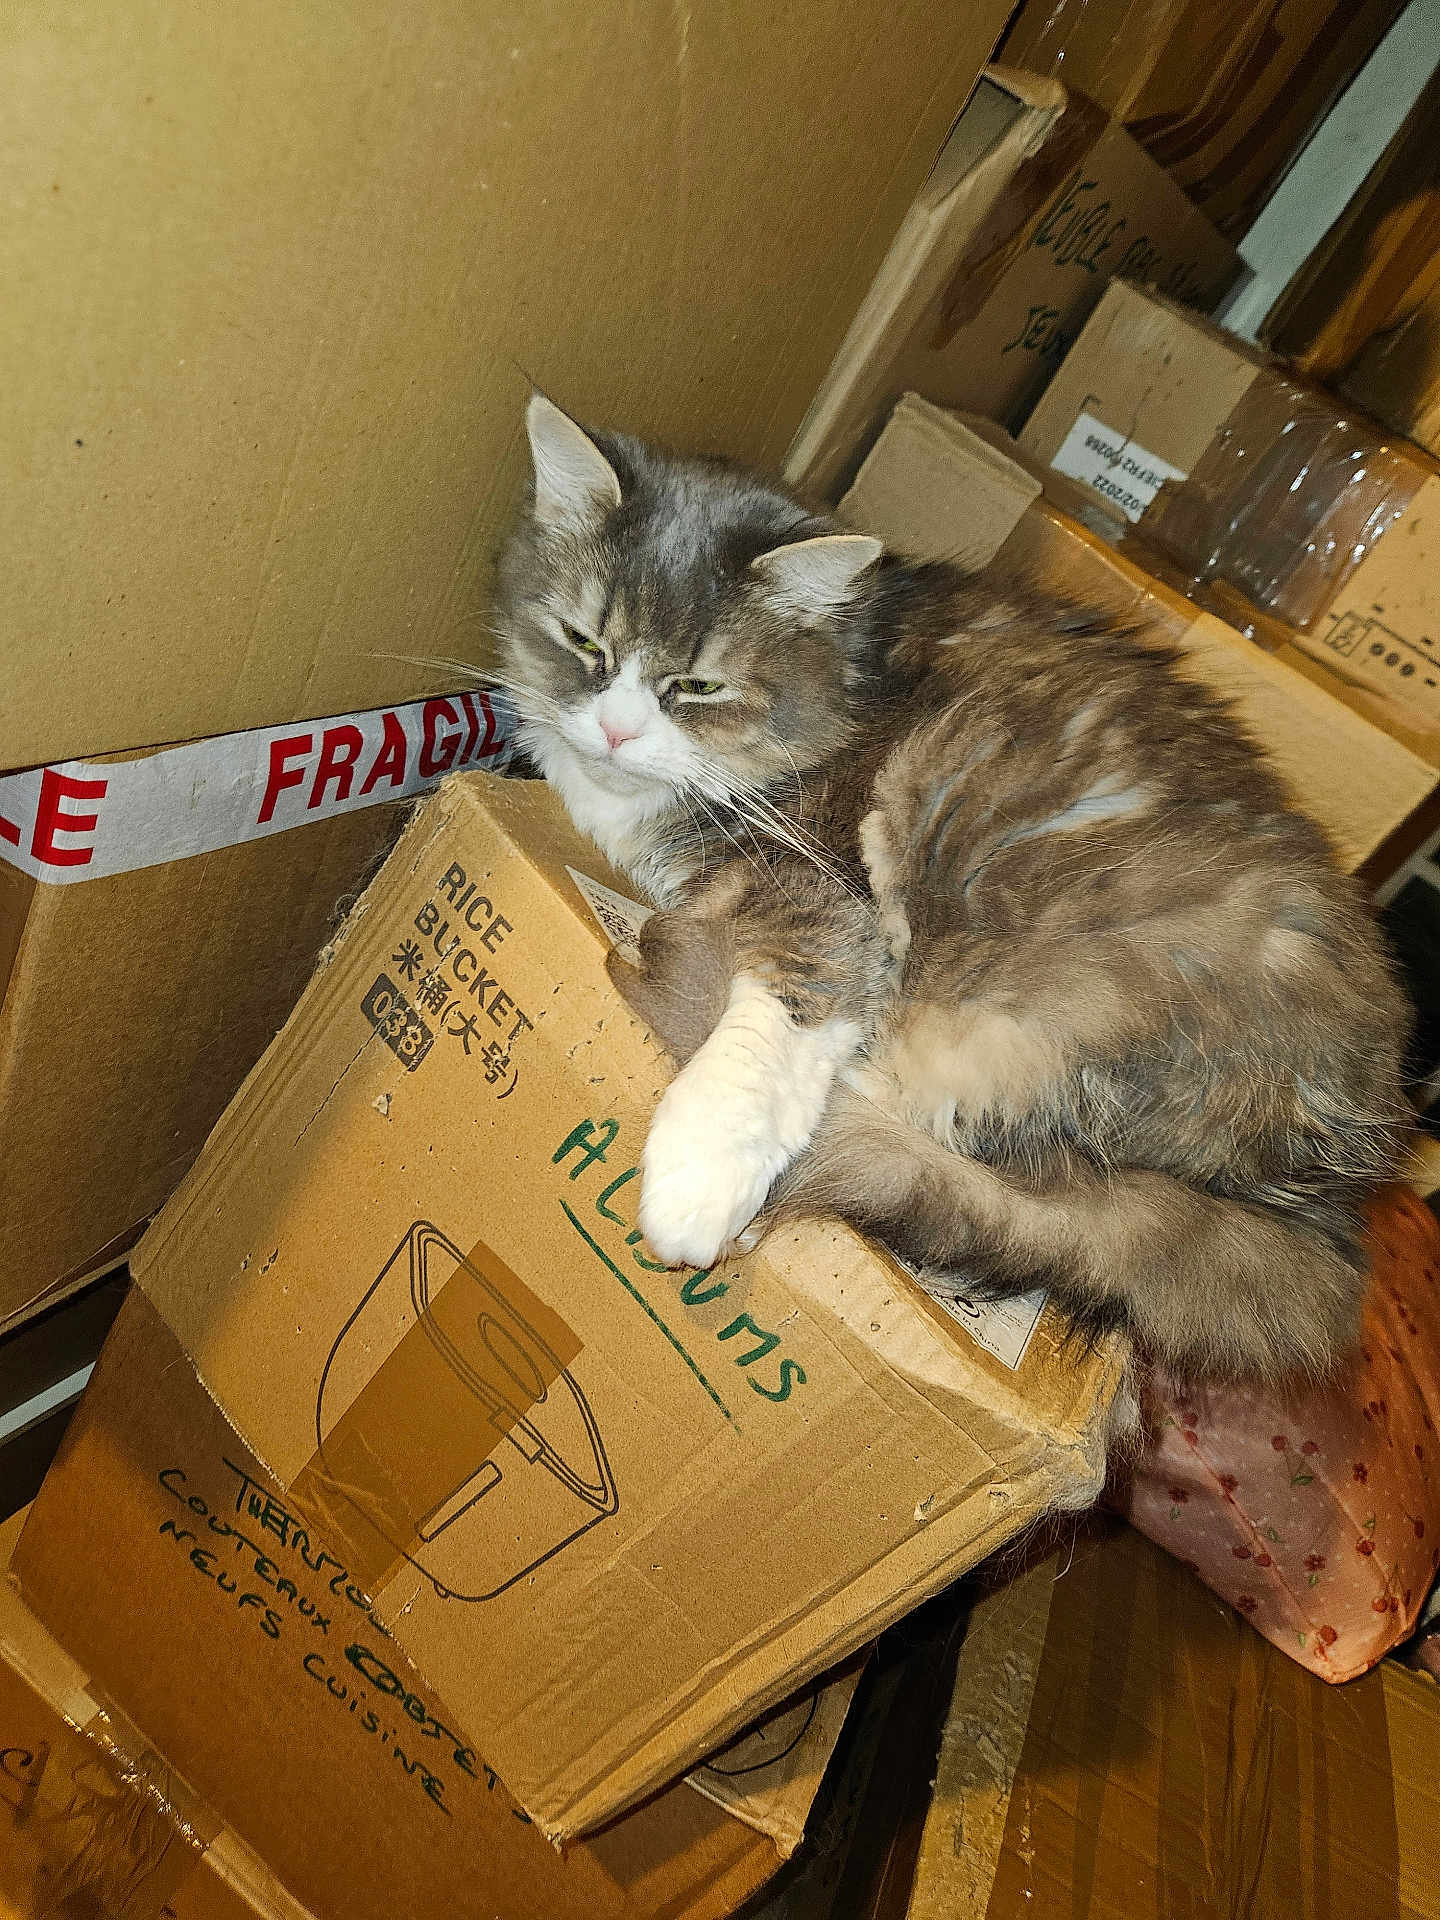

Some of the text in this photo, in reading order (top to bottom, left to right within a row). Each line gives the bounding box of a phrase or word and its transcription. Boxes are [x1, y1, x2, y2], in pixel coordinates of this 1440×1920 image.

[0, 767, 108, 867] E
[256, 690, 515, 824] FRAGIL
[438, 861, 514, 954] RICE
[415, 903, 534, 1040] BUCKET
[159, 1468, 331, 1635] COUTEAUX
[160, 1519, 283, 1640] NEUFS
